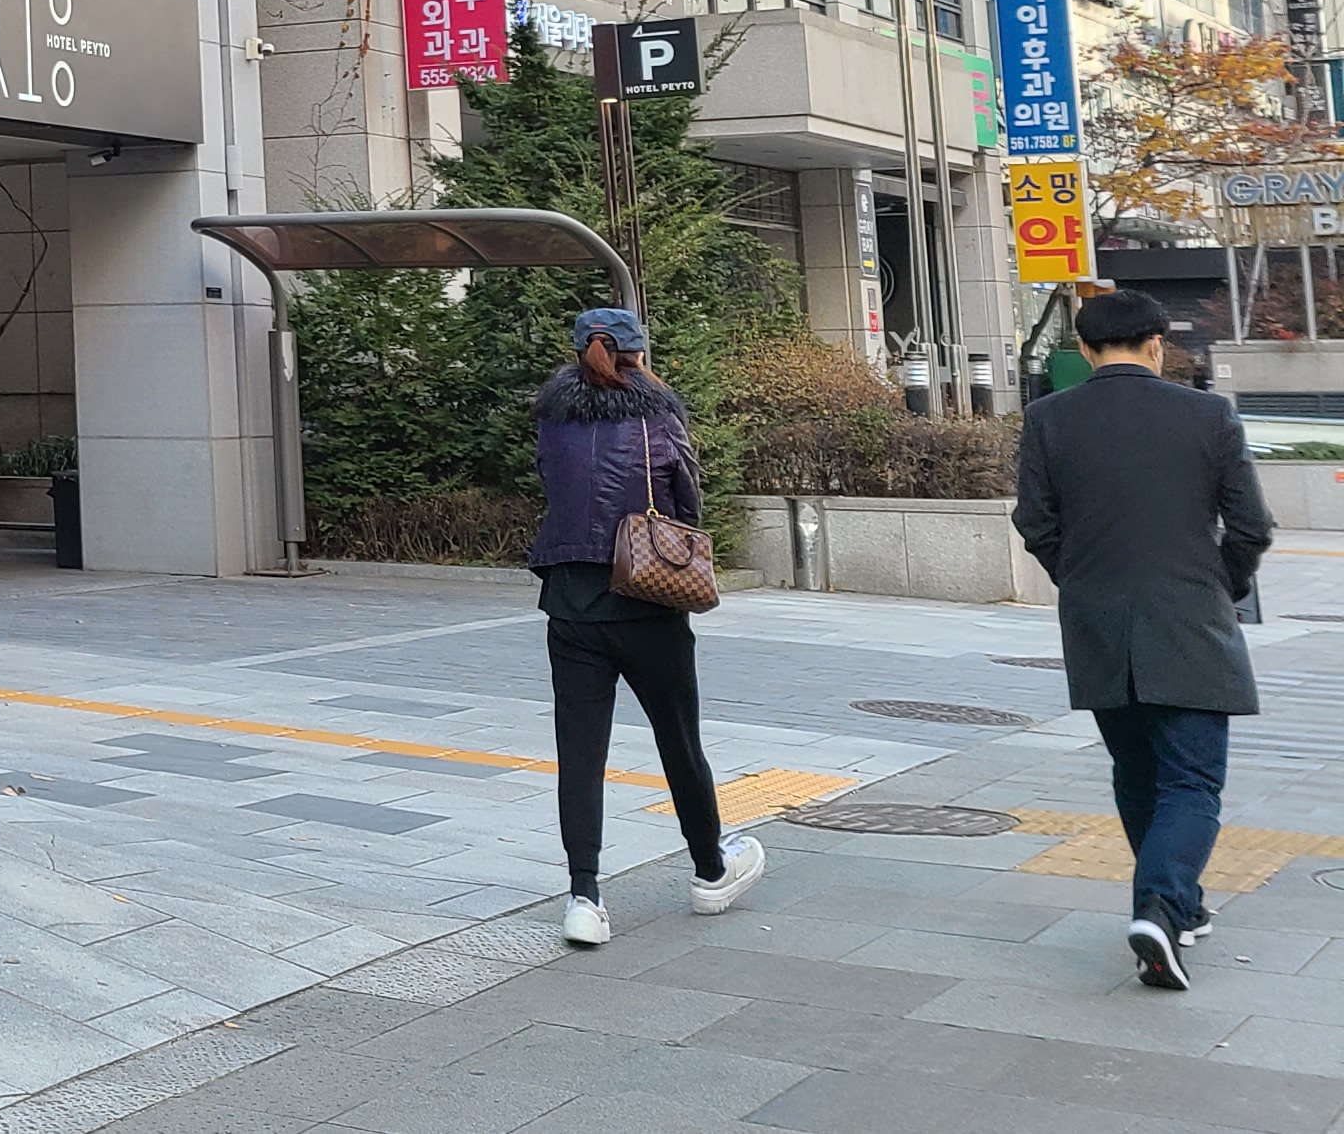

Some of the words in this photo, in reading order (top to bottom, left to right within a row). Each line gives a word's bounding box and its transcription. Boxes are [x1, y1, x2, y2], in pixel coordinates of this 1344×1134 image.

[46, 33, 78, 52] HOTEL
[80, 40, 111, 59] PEYTO
[640, 39, 675, 81] P
[626, 84, 660, 94] HOTEL
[662, 81, 696, 91] PEYTO
[1014, 101, 1070, 131] 의원
[1010, 135, 1060, 151] 561.7582
[1014, 172, 1078, 205] 소망
[1225, 170, 1344, 206] GRAY
[1311, 207, 1344, 236] B
[1019, 214, 1083, 274] 약
